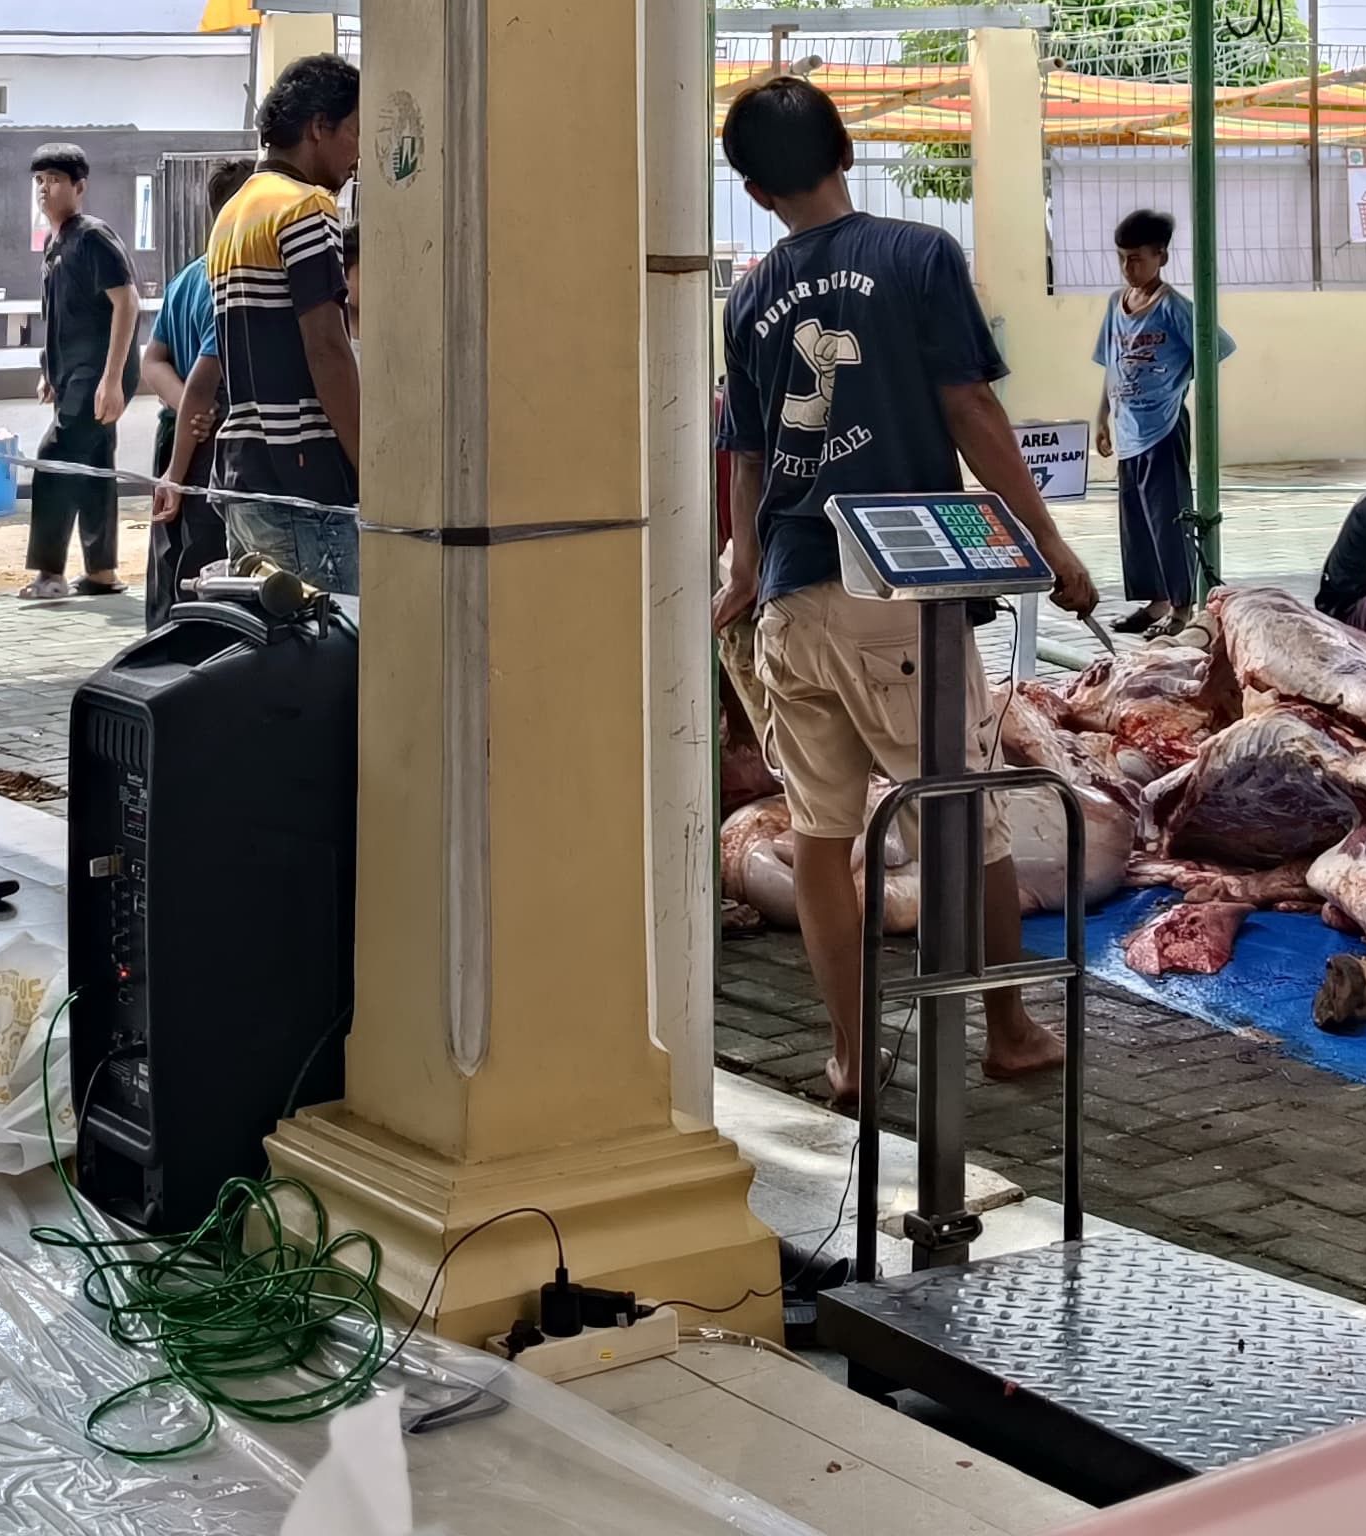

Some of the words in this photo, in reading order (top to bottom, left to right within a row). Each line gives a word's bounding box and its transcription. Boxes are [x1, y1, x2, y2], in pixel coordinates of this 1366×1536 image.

[754, 281, 813, 339] DULUR
[817, 270, 875, 297] DULUR
[1021, 431, 1060, 448] AREA
[1024, 452, 1059, 465] ULITAN
[1061, 450, 1085, 462] SAPI
[938, 505, 946, 514] 7
[952, 505, 961, 514] 8
[966, 505, 976, 514] 9
[946, 516, 954, 524] 4
[960, 515, 969, 524] 5
[975, 515, 983, 524] 6
[953, 526, 961, 535] 1
[968, 526, 976, 535] 2
[982, 526, 991, 535] 3
[960, 537, 969, 546] 0
